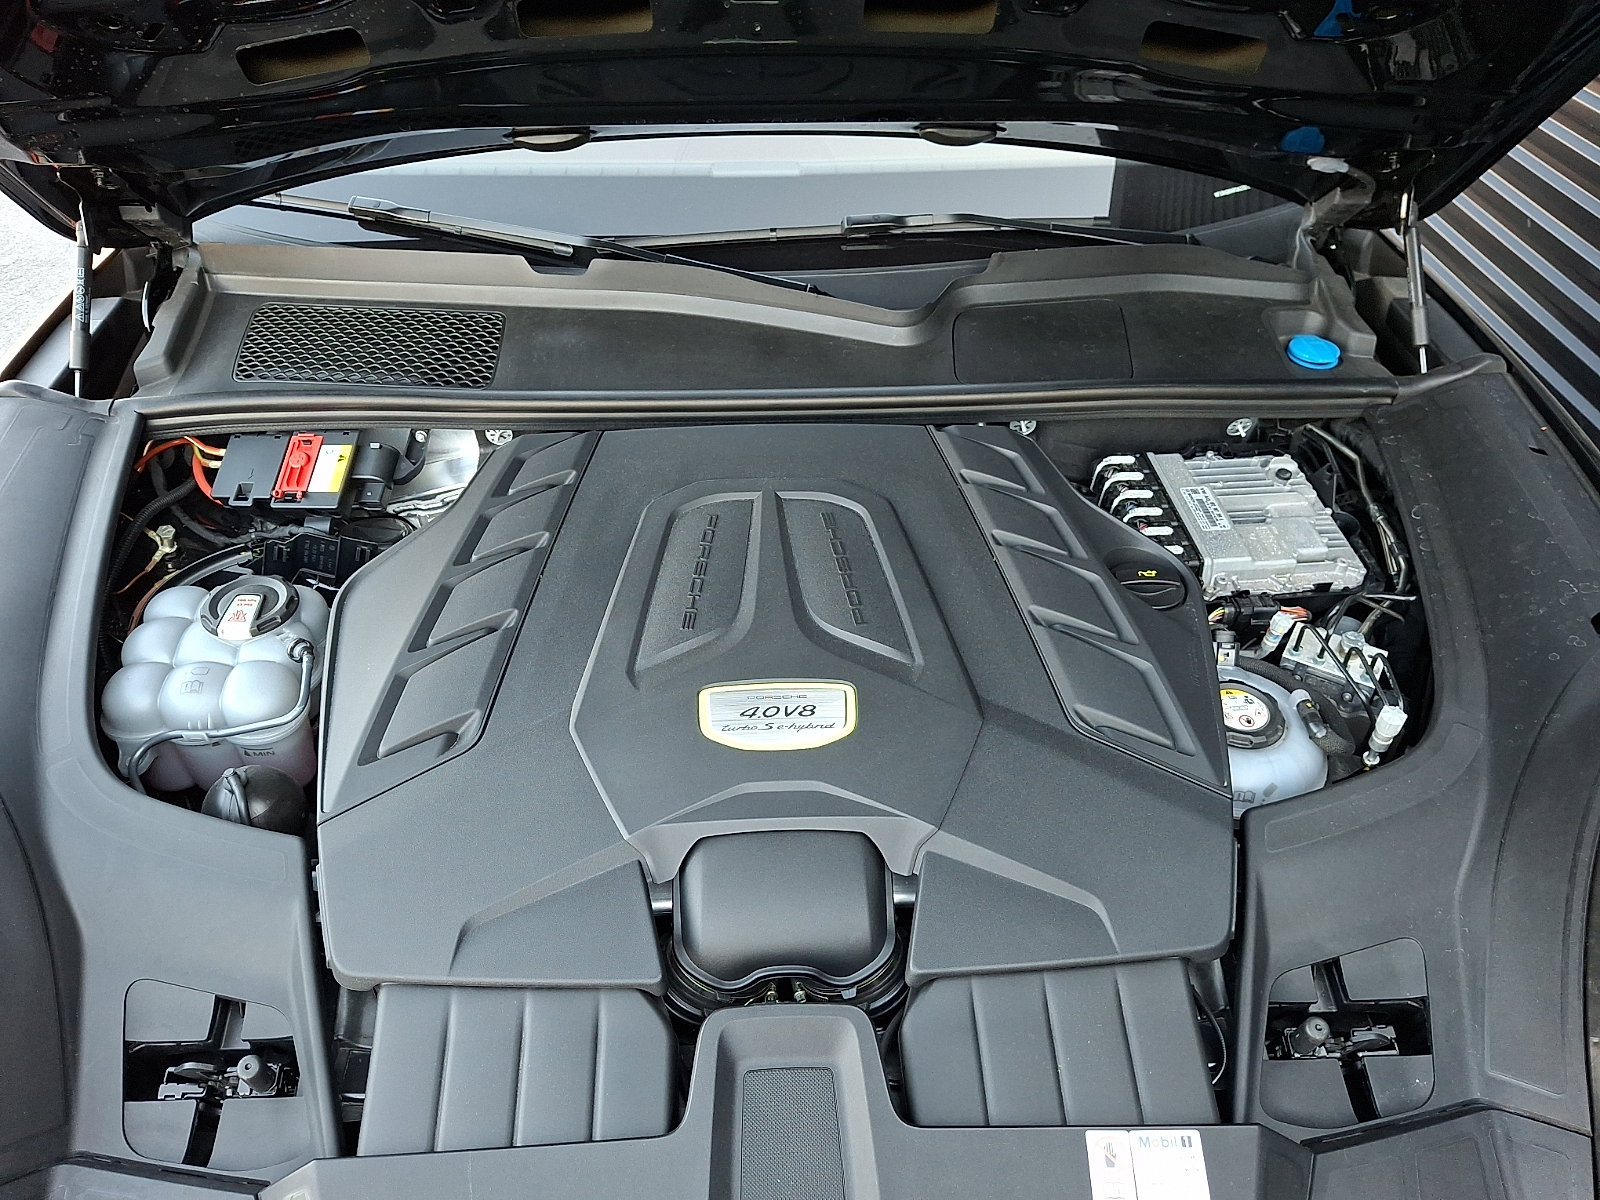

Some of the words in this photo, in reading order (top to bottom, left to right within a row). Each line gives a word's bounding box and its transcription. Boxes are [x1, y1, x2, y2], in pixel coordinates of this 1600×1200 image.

[680, 513, 719, 631] PORSCHE
[820, 511, 869, 627] PORSCHE
[776, 722, 836, 733] e-hybrid
[1138, 1135, 1178, 1149] Mobil
[1181, 1135, 1193, 1148] 1
